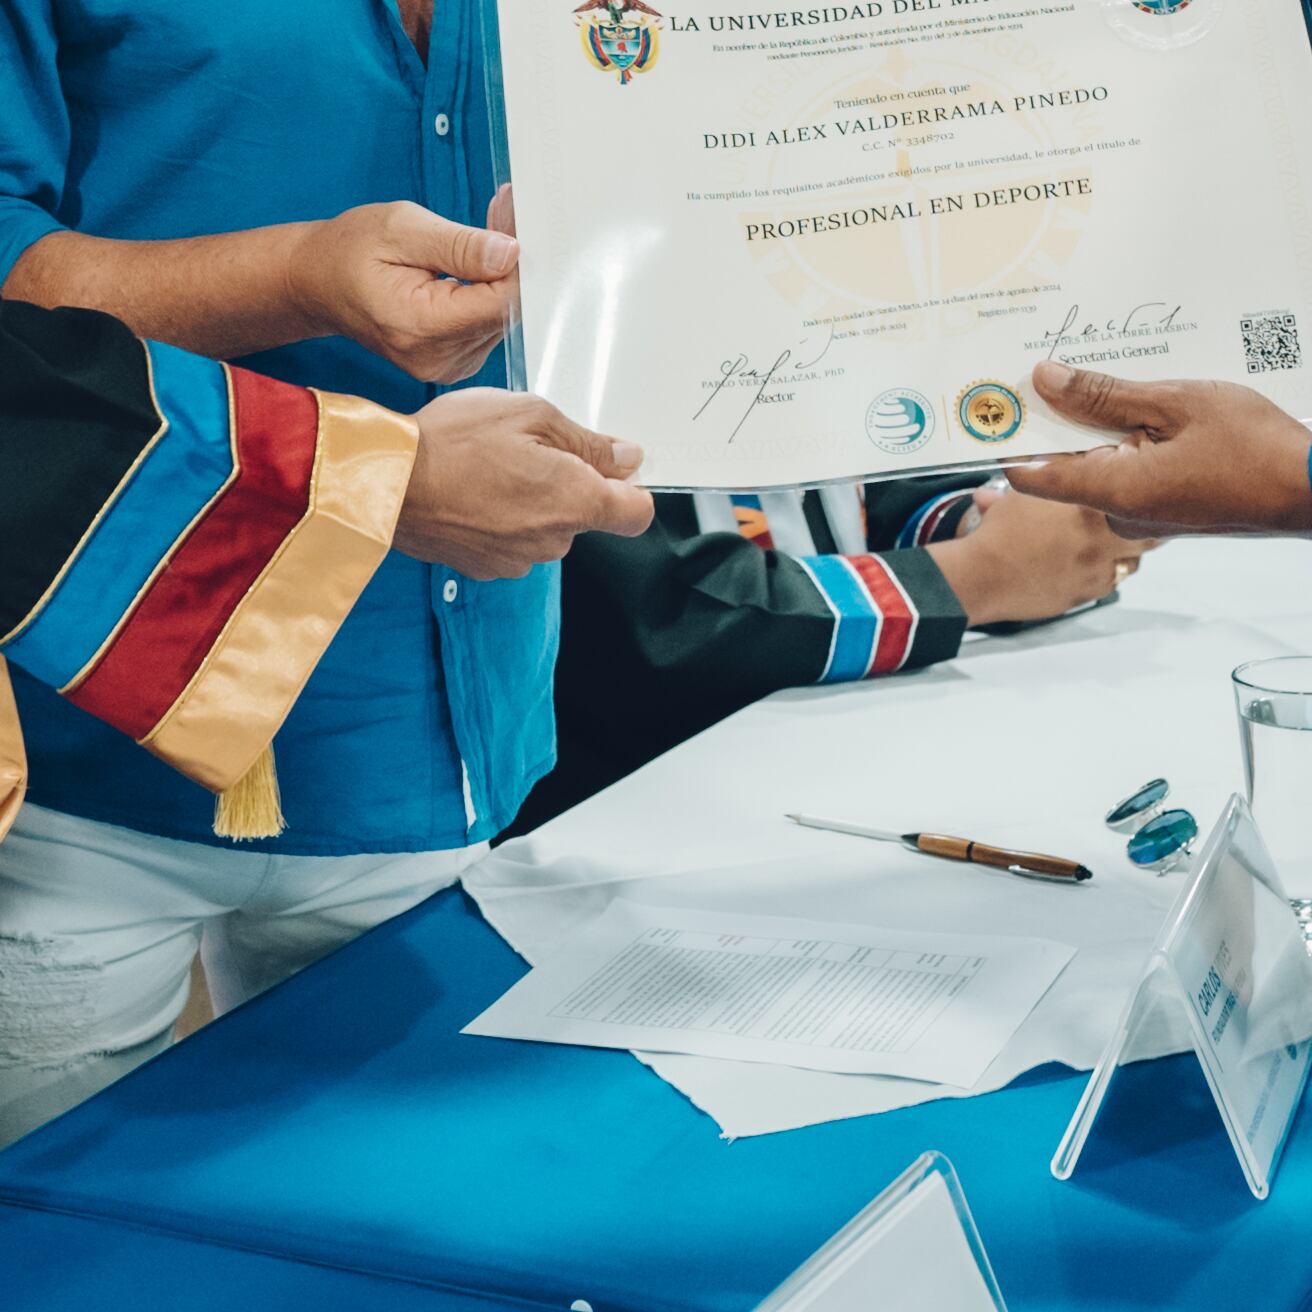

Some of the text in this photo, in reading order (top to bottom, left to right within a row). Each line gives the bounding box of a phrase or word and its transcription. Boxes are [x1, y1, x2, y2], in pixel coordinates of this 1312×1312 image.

[670, 15, 701, 32] LA
[709, 1, 884, 32] UNIVERSIDAD
[834, 82, 971, 110] Teniendo en cuenta que
[702, 86, 1109, 150] DIDI ALEX VALDERRAMA PINEDO
[862, 139, 885, 152] C.C.
[905, 131, 955, 147] 3348702
[686, 136, 1142, 202] Ha cumplido los requisitos académicos exigidos por la universidad, le otorga el título de
[746, 177, 1093, 241] PROFESIONAL EN DEPORTE
[1024, 334, 1081, 350] MERCEDES
[1083, 333, 1098, 344] DE
[1101, 330, 1115, 341] LA
[1116, 327, 1151, 339] TORRE
[1122, 341, 1170, 359] General
[701, 378, 736, 389] PABLO
[739, 376, 767, 387] VERA
[757, 391, 796, 405] Rector
[1197, 964, 1222, 1017] CARLOS
